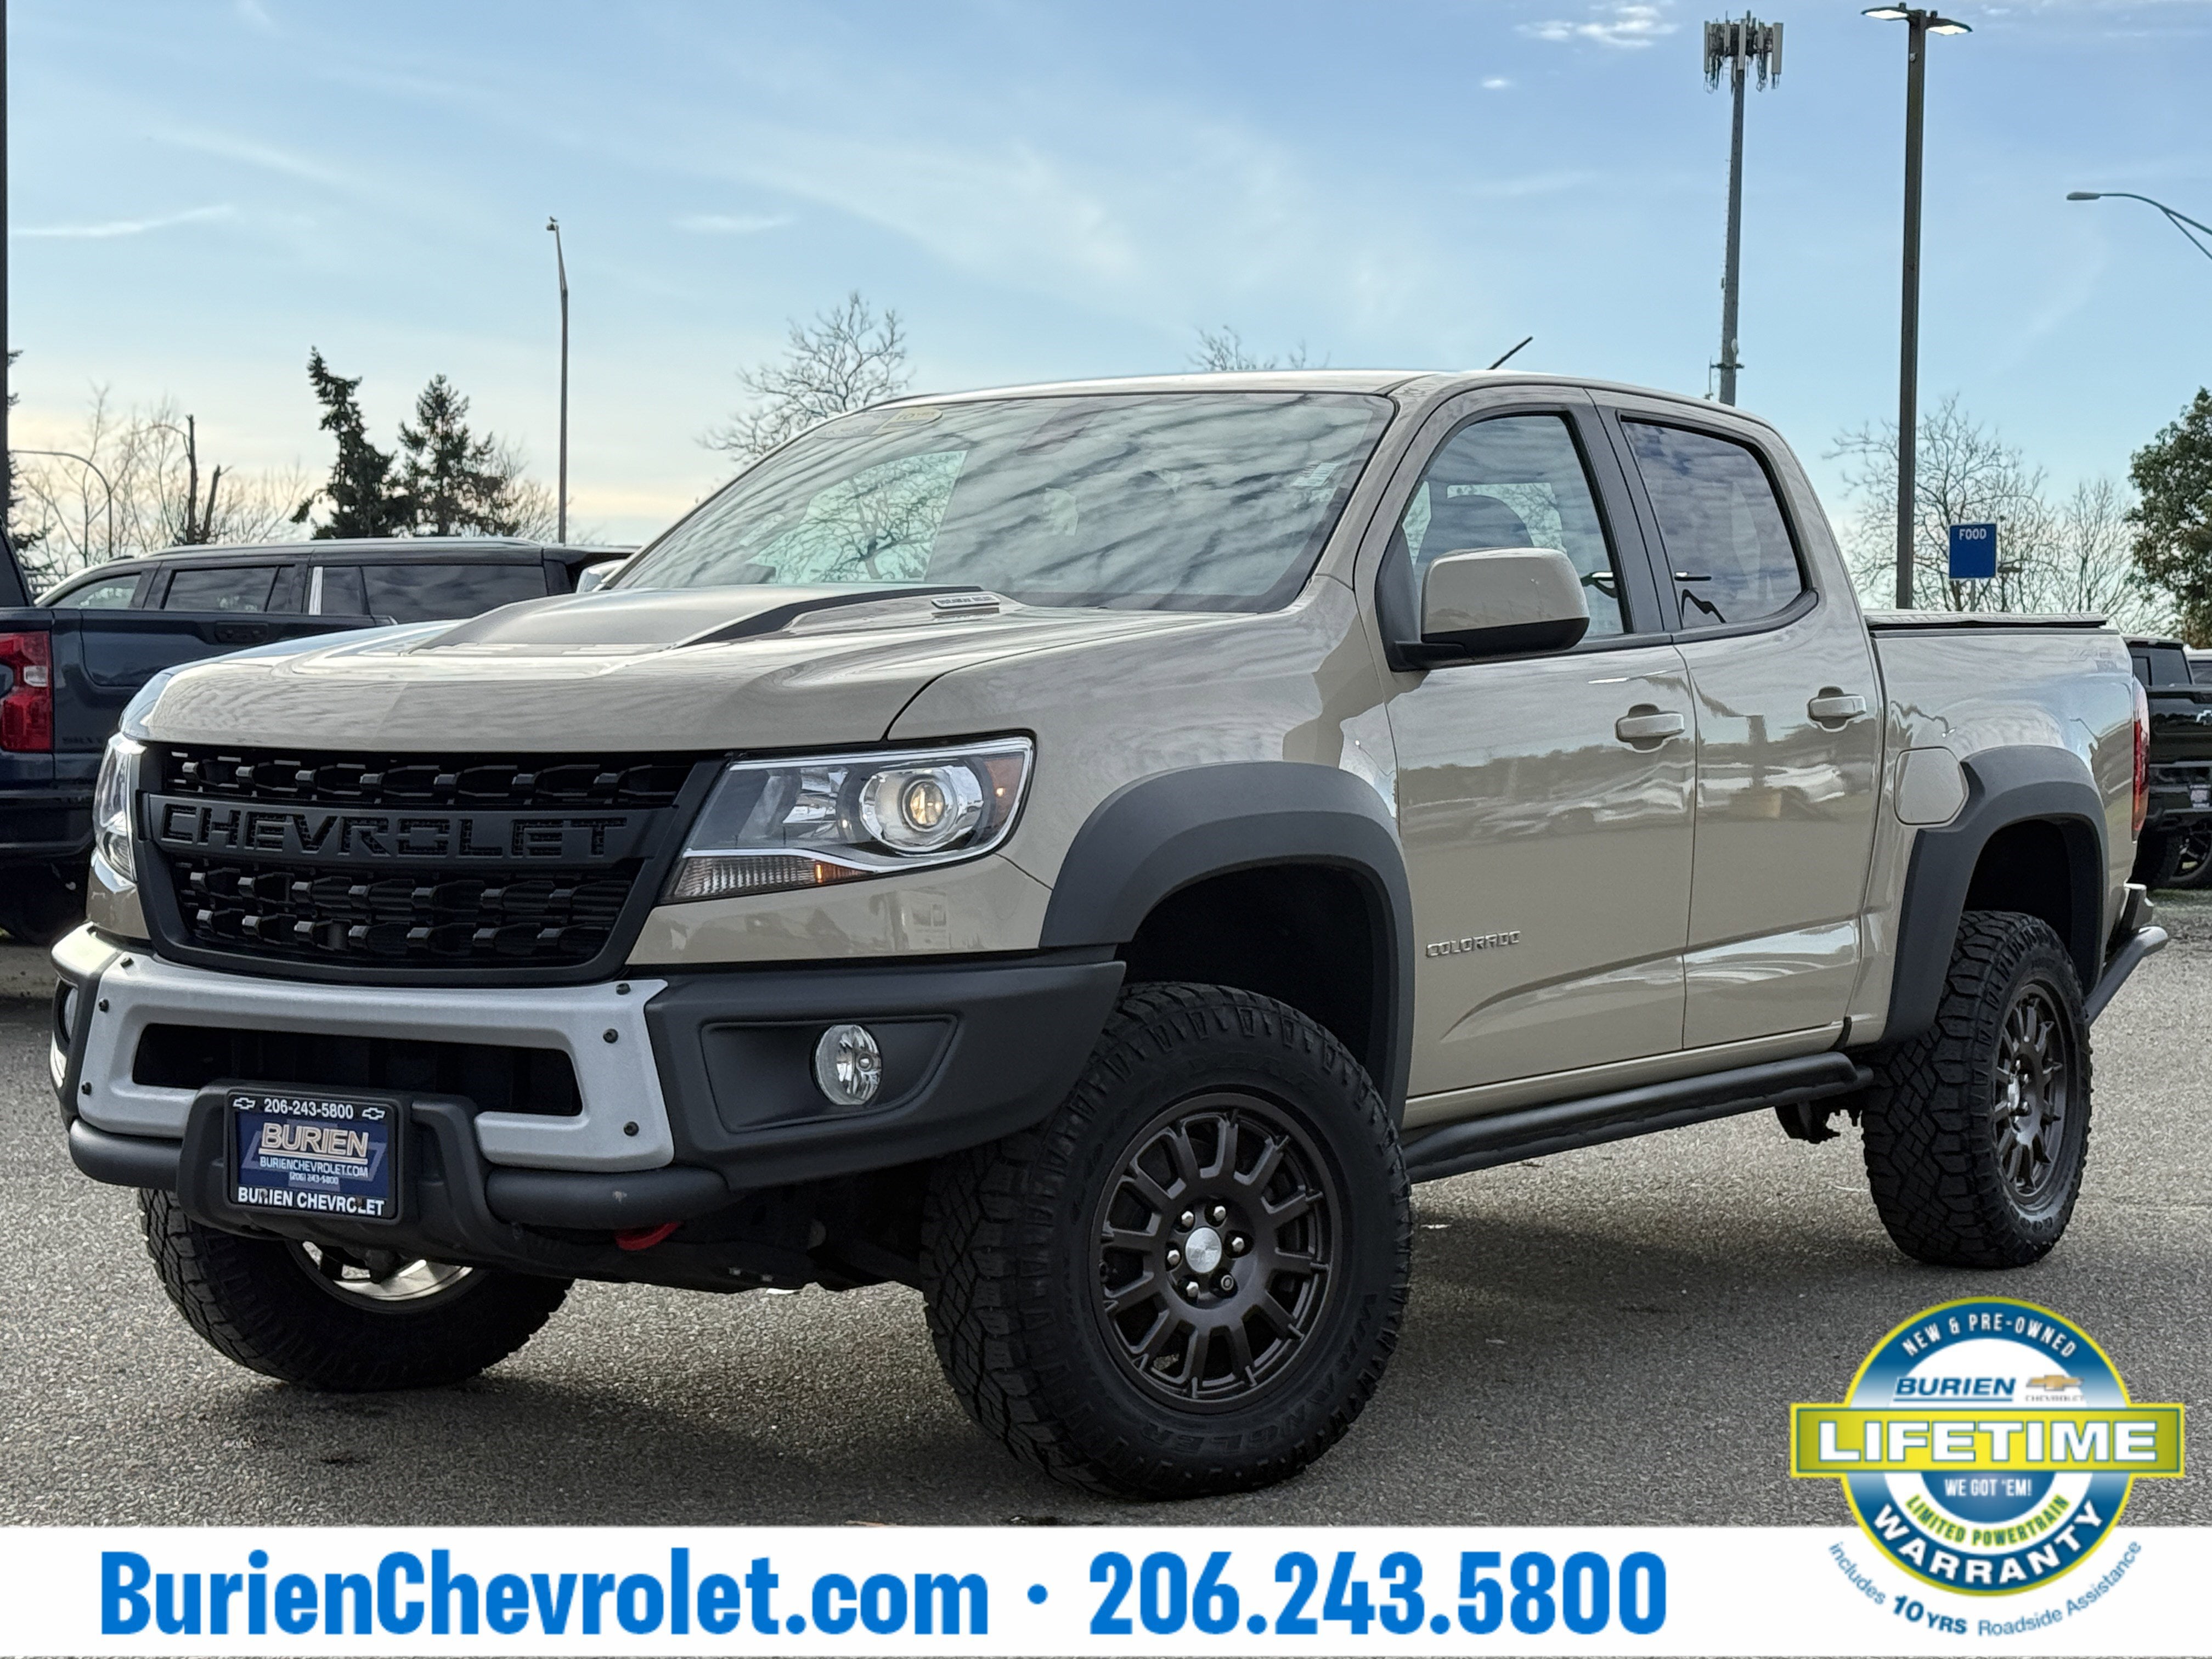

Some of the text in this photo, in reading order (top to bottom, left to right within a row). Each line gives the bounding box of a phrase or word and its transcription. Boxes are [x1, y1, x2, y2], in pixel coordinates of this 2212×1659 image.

[1959, 528, 1987, 541] FOOD
[161, 803, 629, 860] CHEVROLET
[1426, 930, 1521, 957] COLORADO
[263, 1098, 354, 1120] 206-243-5800
[261, 1122, 369, 1157] BURIEN
[259, 1156, 369, 1178] BURIENCHEVROLET.COM
